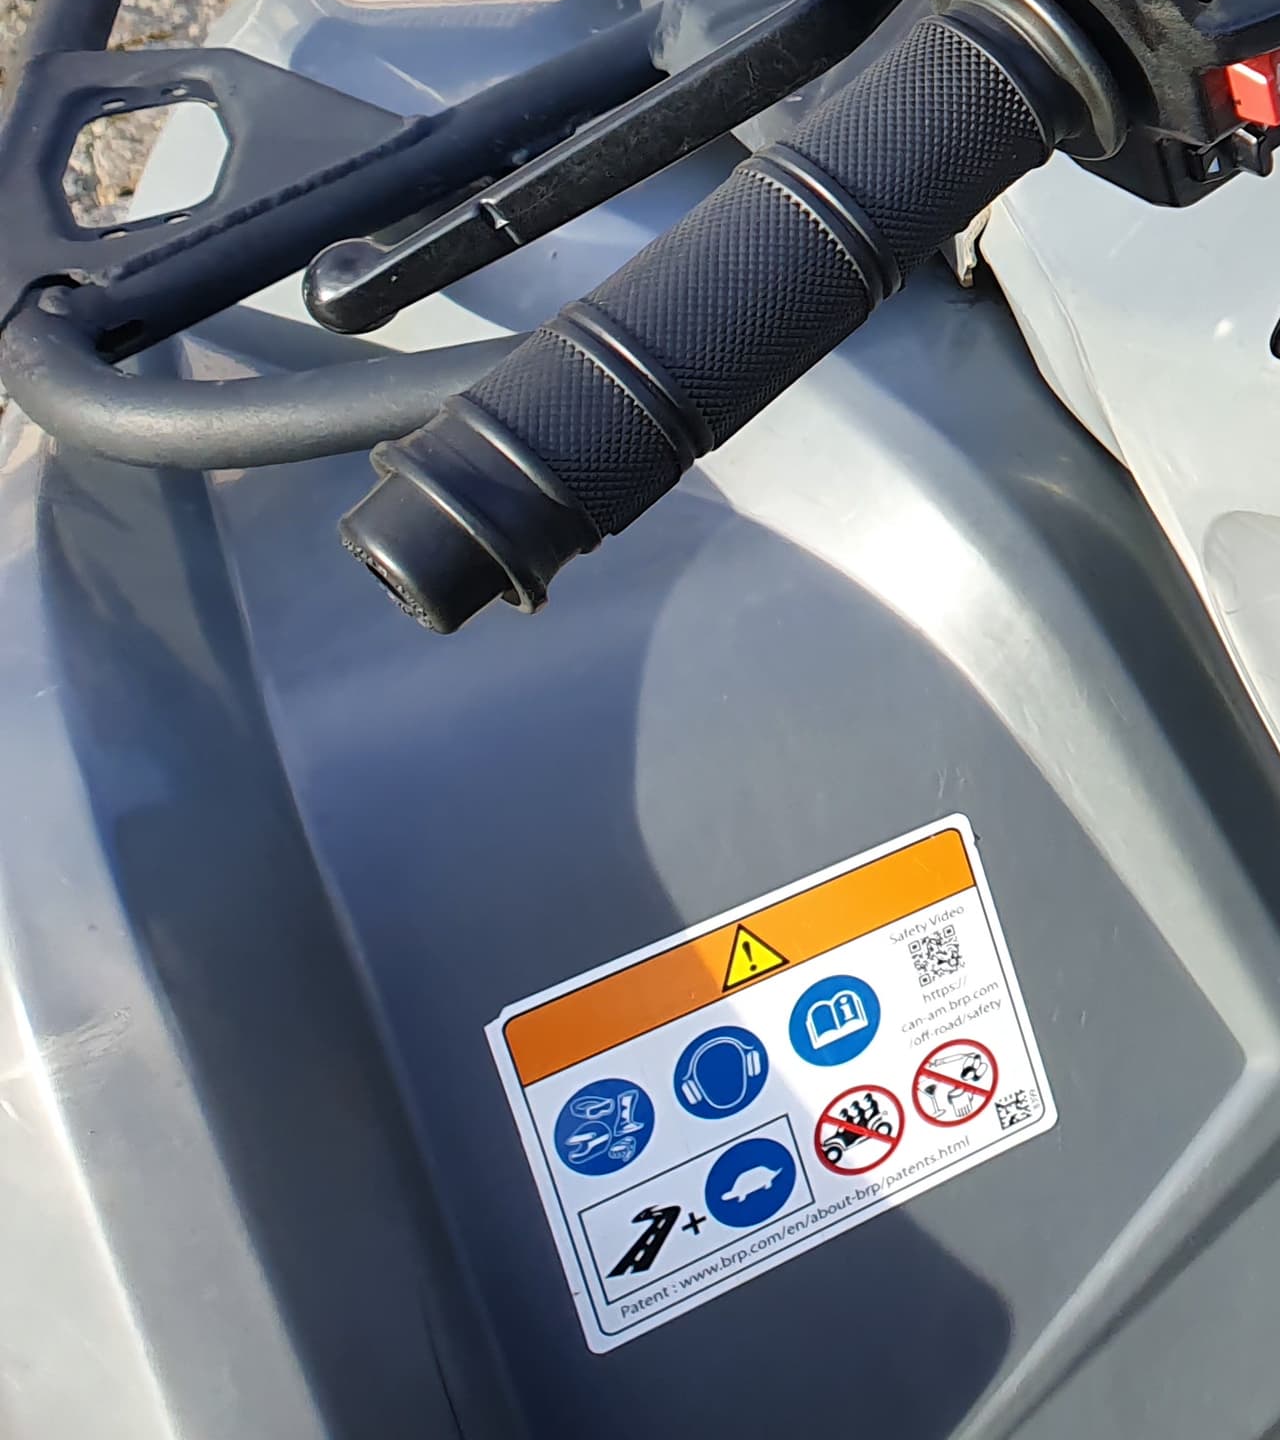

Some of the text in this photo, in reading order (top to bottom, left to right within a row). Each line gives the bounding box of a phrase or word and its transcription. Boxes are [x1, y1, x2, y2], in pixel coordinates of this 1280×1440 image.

[889, 905, 965, 945] Safety Video
[620, 1285, 670, 1319] Patent
[679, 1135, 971, 1291] www.brp.com/en/about-brp/patents.html
